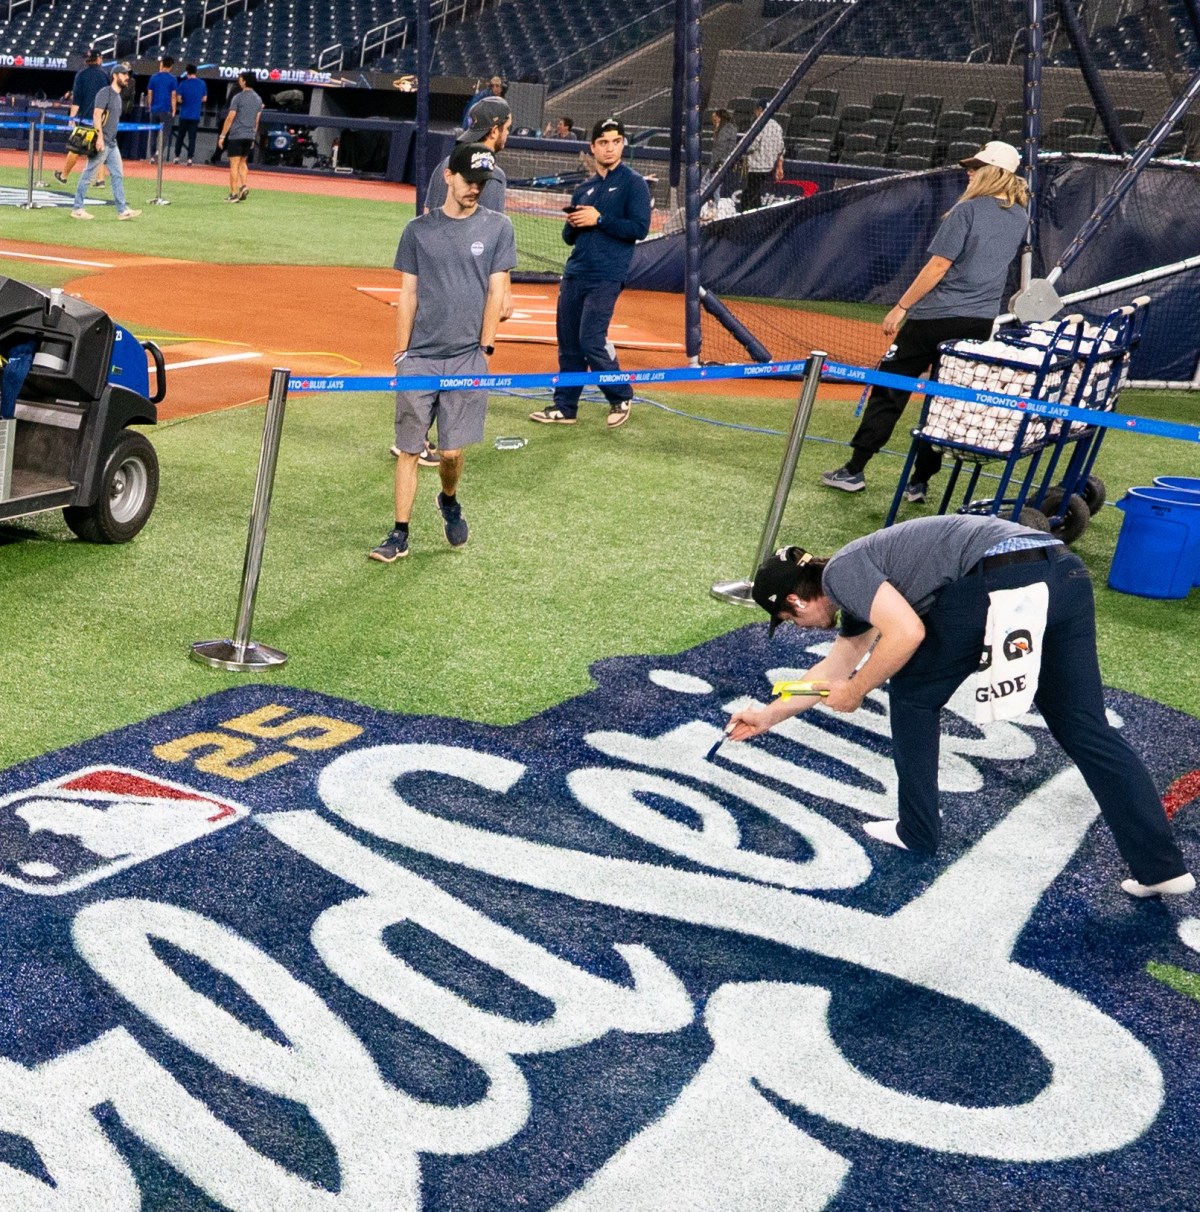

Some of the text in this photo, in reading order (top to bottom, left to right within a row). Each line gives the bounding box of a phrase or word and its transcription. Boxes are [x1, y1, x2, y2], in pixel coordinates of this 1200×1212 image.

[24, 56, 45, 67] BLUE
[46, 58, 67, 68] JAYS
[219, 67, 331, 82] TORTO BLUE JAYS
[115, 330, 123, 341] 23
[743, 366, 772, 375] TORONTO
[777, 364, 791, 372] BLUE
[829, 366, 866, 379] BLUE JAYS
[439, 378, 473, 387] TORONTO
[479, 378, 495, 386] BLUE
[495, 377, 511, 386] JAYS
[599, 372, 665, 383] TORONTO BLUE JAYS
[309, 380, 327, 389] BLUE
[327, 380, 344, 389] JAYS
[976, 393, 1069, 416] TORONTO BLUE JAYS
[152, 703, 366, 781] 25
